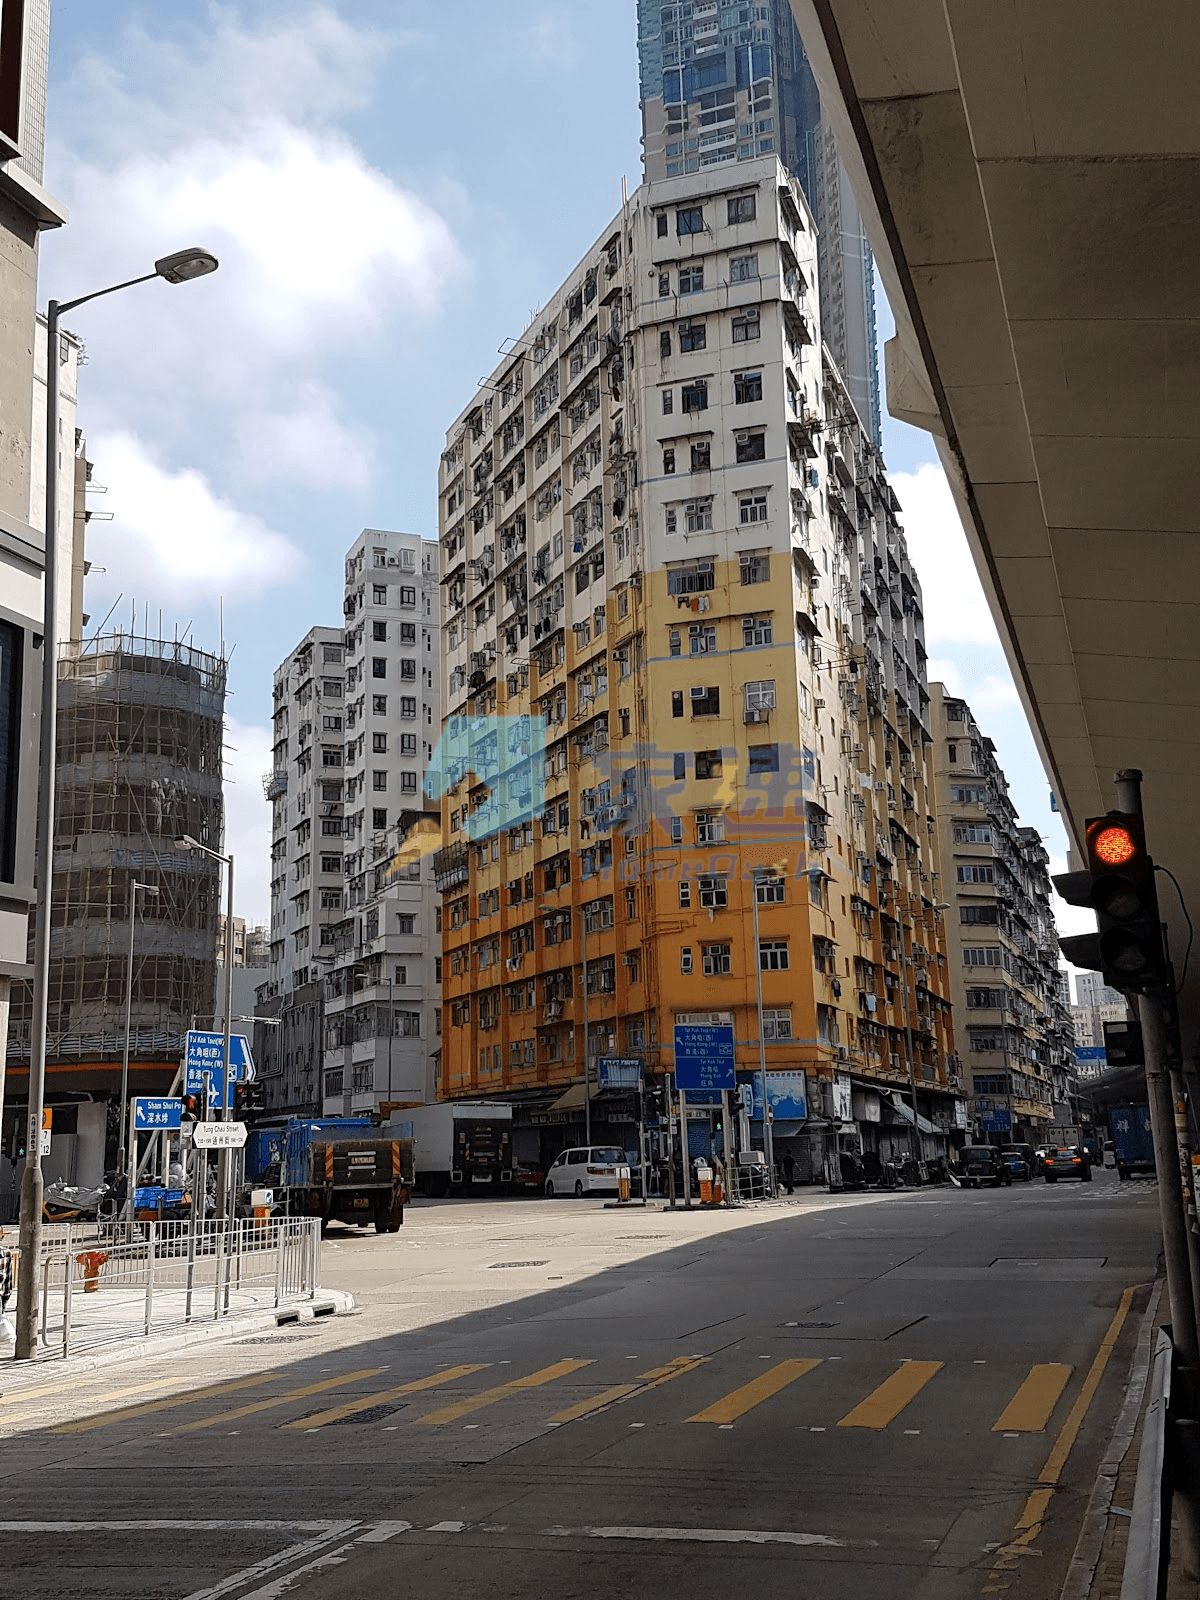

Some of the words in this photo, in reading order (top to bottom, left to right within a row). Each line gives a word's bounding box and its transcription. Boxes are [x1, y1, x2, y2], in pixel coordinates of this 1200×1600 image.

[188, 1058, 201, 1067] Hong
[202, 1059, 213, 1068] Kong
[147, 1101, 161, 1110] Sham
[162, 1102, 173, 1110] Shui
[174, 1102, 181, 1110] Po
[203, 1125, 214, 1134] Tung
[215, 1125, 225, 1133] Chau
[226, 1125, 240, 1133] Street
